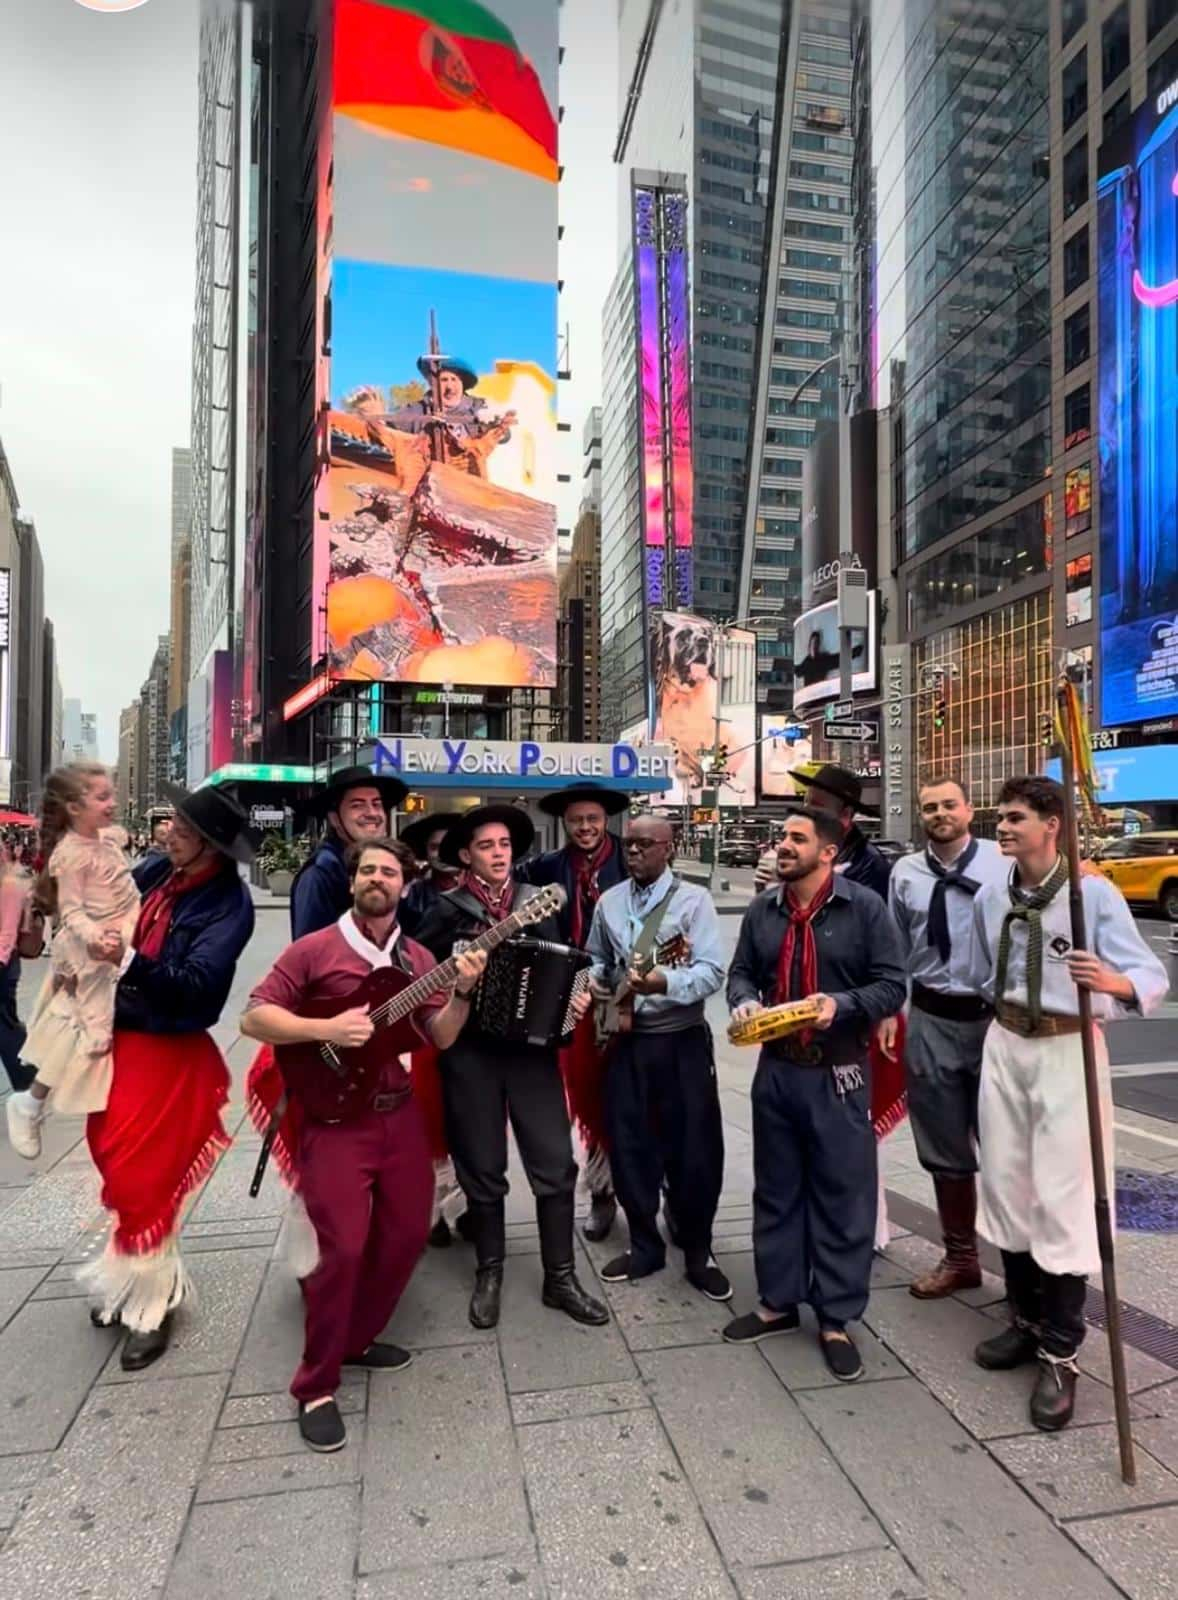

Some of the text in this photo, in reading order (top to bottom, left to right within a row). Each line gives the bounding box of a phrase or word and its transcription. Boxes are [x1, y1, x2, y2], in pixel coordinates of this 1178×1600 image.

[889, 657, 902, 816] 3 TIMES SQUARE
[1089, 730, 1121, 750] T&T
[443, 740, 512, 775] YORK
[520, 743, 602, 777] POLICE
